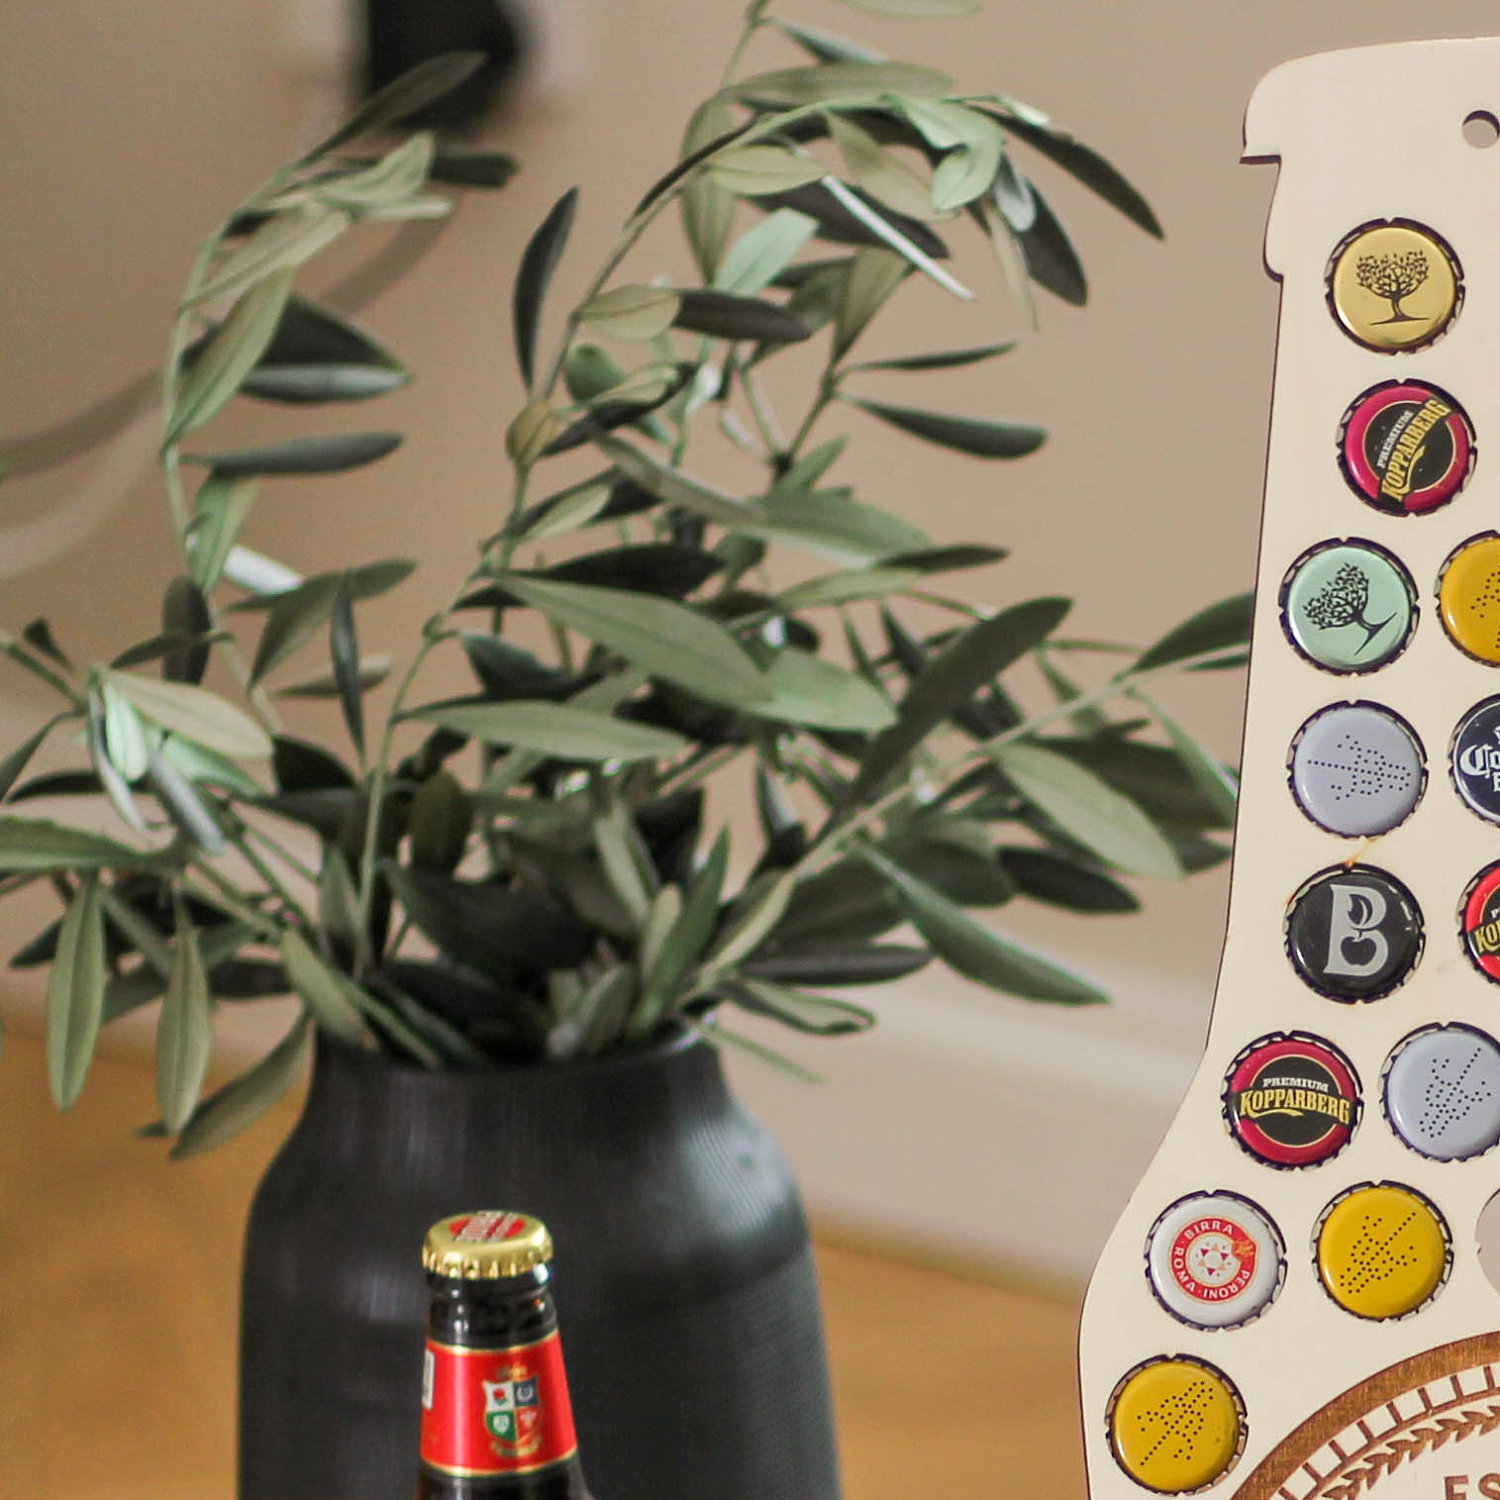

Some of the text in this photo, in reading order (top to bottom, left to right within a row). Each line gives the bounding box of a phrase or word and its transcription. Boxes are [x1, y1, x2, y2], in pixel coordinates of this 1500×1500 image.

[1377, 410, 1414, 469] PREMIUM
[1380, 400, 1451, 502] KOPPARBERG
[1322, 884, 1389, 977] B
[1262, 1077, 1329, 1092] PREMIUM
[1239, 1088, 1350, 1125] KOPPARBERG
[1184, 1221, 1234, 1240] BIRRA
[1173, 1246, 1197, 1292] ROMA
[1203, 1269, 1251, 1299] PERONI
